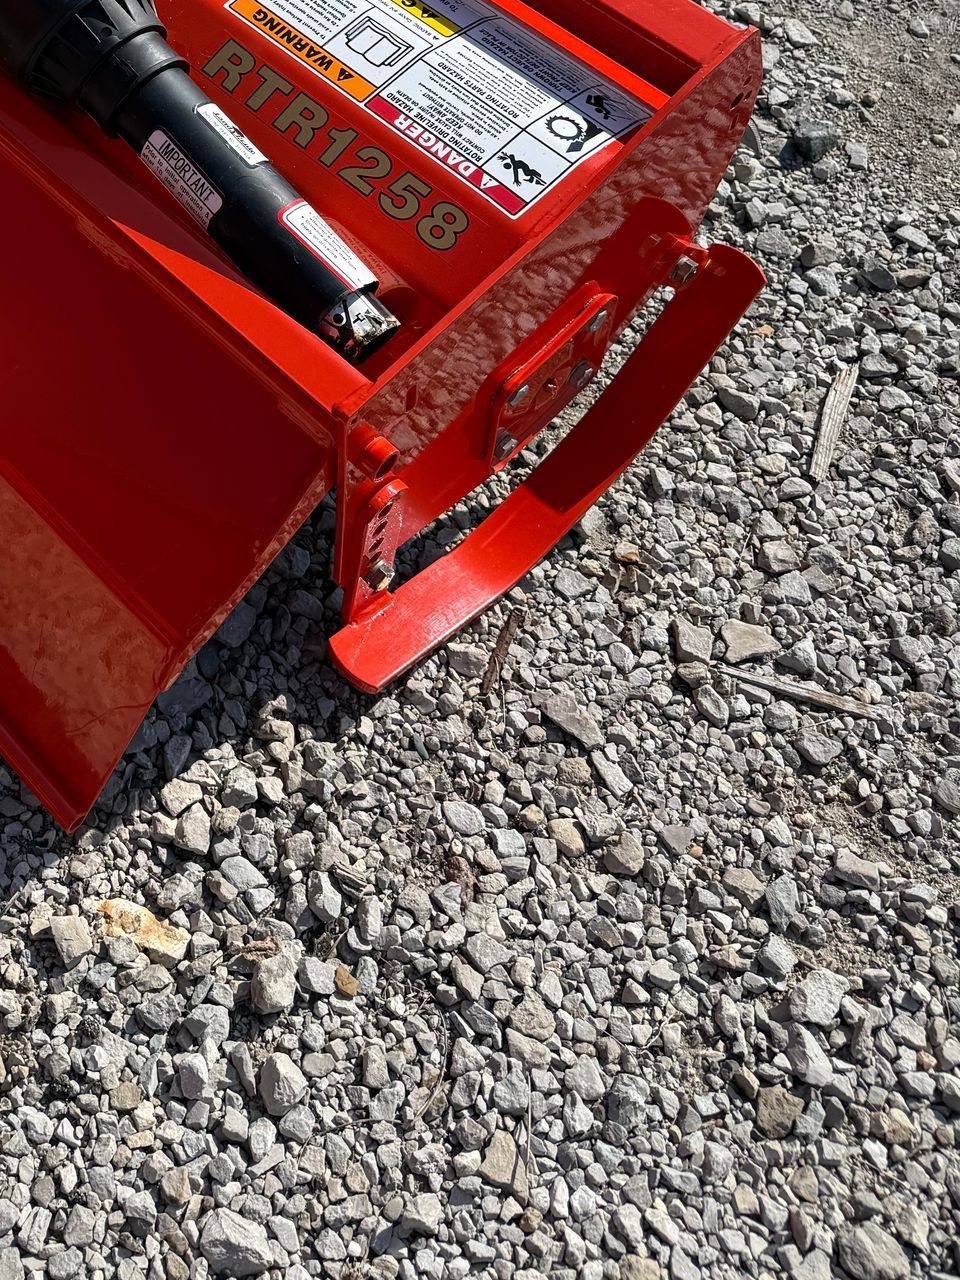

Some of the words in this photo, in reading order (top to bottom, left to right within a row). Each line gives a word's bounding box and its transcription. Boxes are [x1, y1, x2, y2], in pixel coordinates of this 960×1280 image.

[249, 7, 337, 72] WARNING
[478, 27, 501, 43] PLACE
[479, 36, 510, 56] HAZARD
[503, 45, 541, 69] DEFLECTOR
[505, 53, 535, 73] OBJECT
[435, 60, 466, 81] HAZARD
[532, 70, 565, 92] THROWN
[537, 67, 561, 83] FRONT
[462, 78, 487, 96] PARTS
[557, 80, 578, 94] KEEP
[384, 91, 414, 113] HAZARD
[425, 102, 448, 118] AWAY!
[483, 93, 521, 119] ROTATING
[412, 111, 450, 138] DRIVELINE
[444, 115, 464, 129] KEEP
[202, 38, 470, 250] RTR1258
[390, 112, 479, 177] DANGER
[446, 135, 483, 162] ROTATING
[159, 139, 215, 202] IMPORTANT
